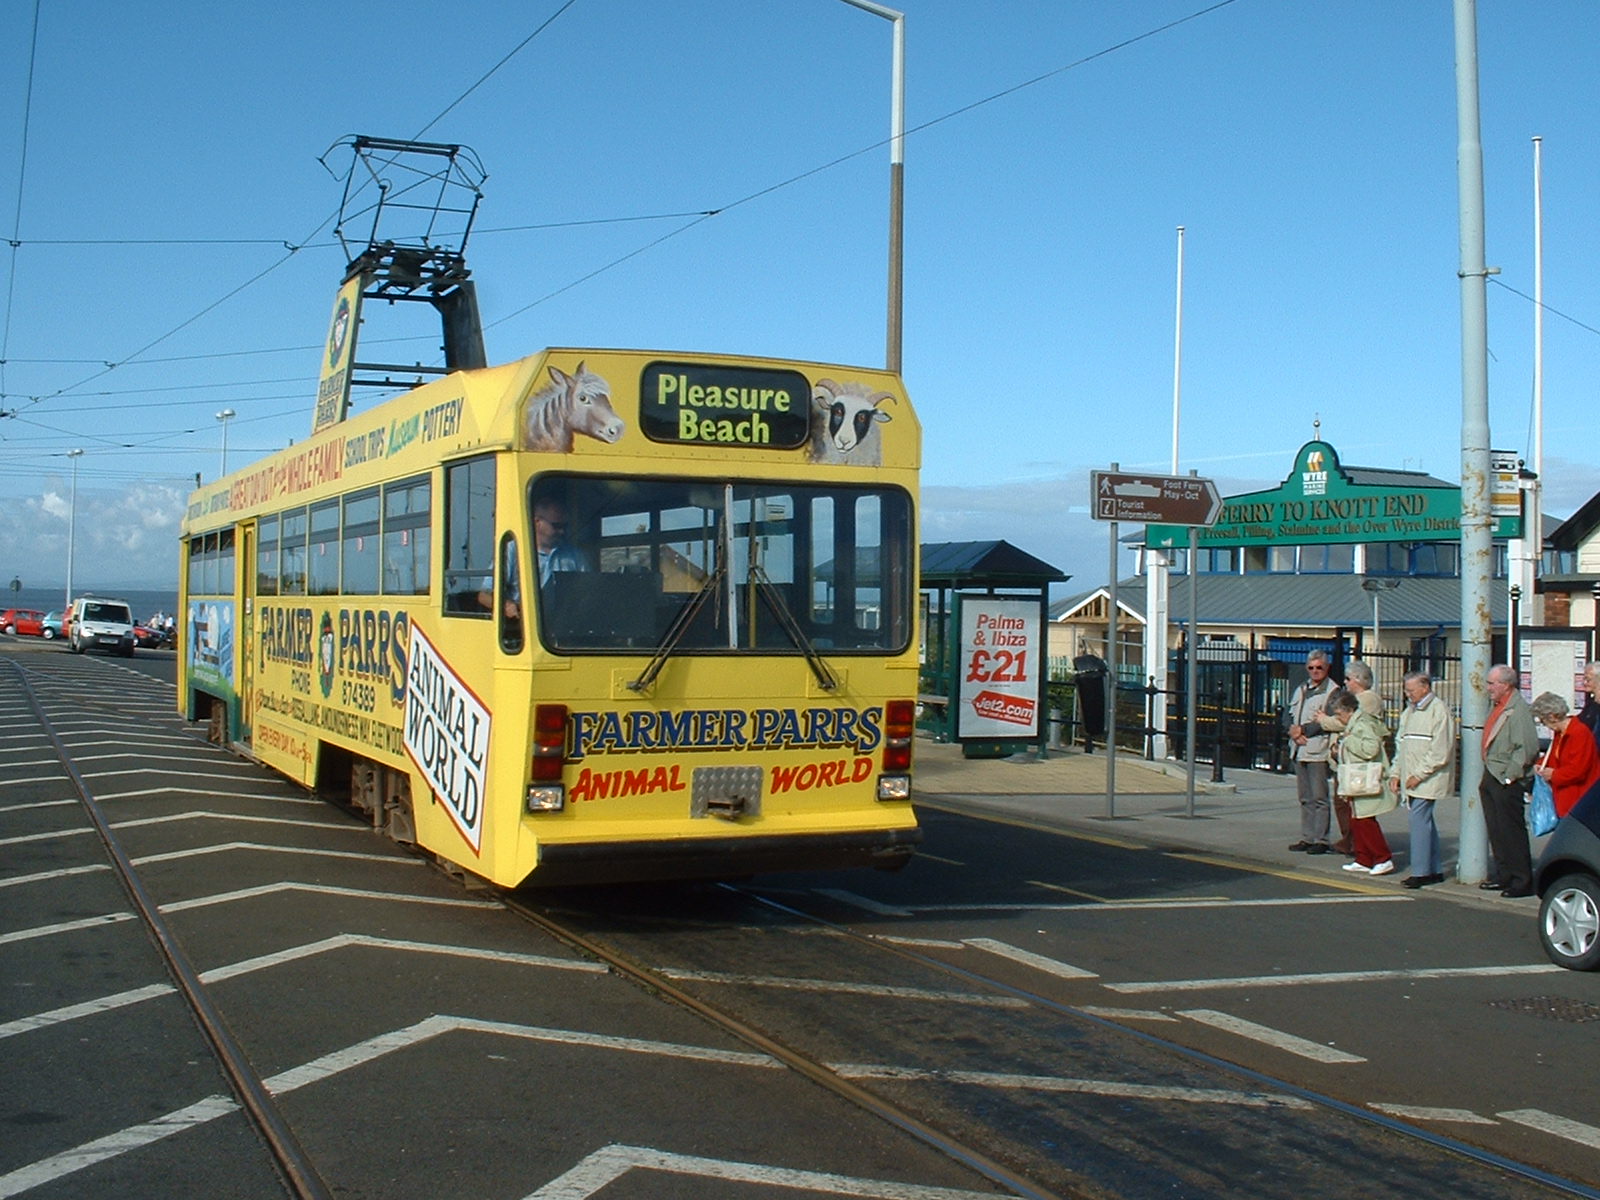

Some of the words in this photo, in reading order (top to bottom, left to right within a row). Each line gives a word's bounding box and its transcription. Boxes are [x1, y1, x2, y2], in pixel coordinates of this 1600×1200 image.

[657, 374, 791, 412] Pleasure
[422, 396, 465, 444] POTTERY
[678, 409, 770, 444] Beach
[1163, 480, 1182, 489] Foot
[1183, 481, 1203, 492] Ferry
[1164, 490, 1180, 500] May
[1185, 491, 1199, 500] Oct
[1117, 499, 1145, 510] Tourist
[1117, 509, 1163, 520] Information
[1217, 503, 1276, 525] FERRY
[1280, 500, 1305, 521] TO
[1310, 496, 1379, 521] KNOTT
[1384, 494, 1428, 517] END
[1322, 522, 1341, 536] and
[1344, 521, 1360, 534] the
[1362, 519, 1388, 533] Over
[1392, 518, 1422, 536] Wyre
[1424, 516, 1461, 531] Distric
[973, 630, 986, 647] &
[991, 630, 1028, 647] Ibiza
[976, 614, 1025, 630] Palma
[260, 606, 313, 674] FARMER
[339, 609, 408, 710] PARRS
[966, 649, 1028, 683] £21
[342, 680, 376, 713] 874389
[410, 641, 484, 772] ANIMAL
[976, 697, 1034, 719] Jet2.com
[567, 707, 748, 763] FARMER
[751, 706, 884, 757] PARRS
[408, 687, 479, 830] WORLD
[569, 764, 687, 803] ANIMAL
[770, 757, 874, 796] WORLD
